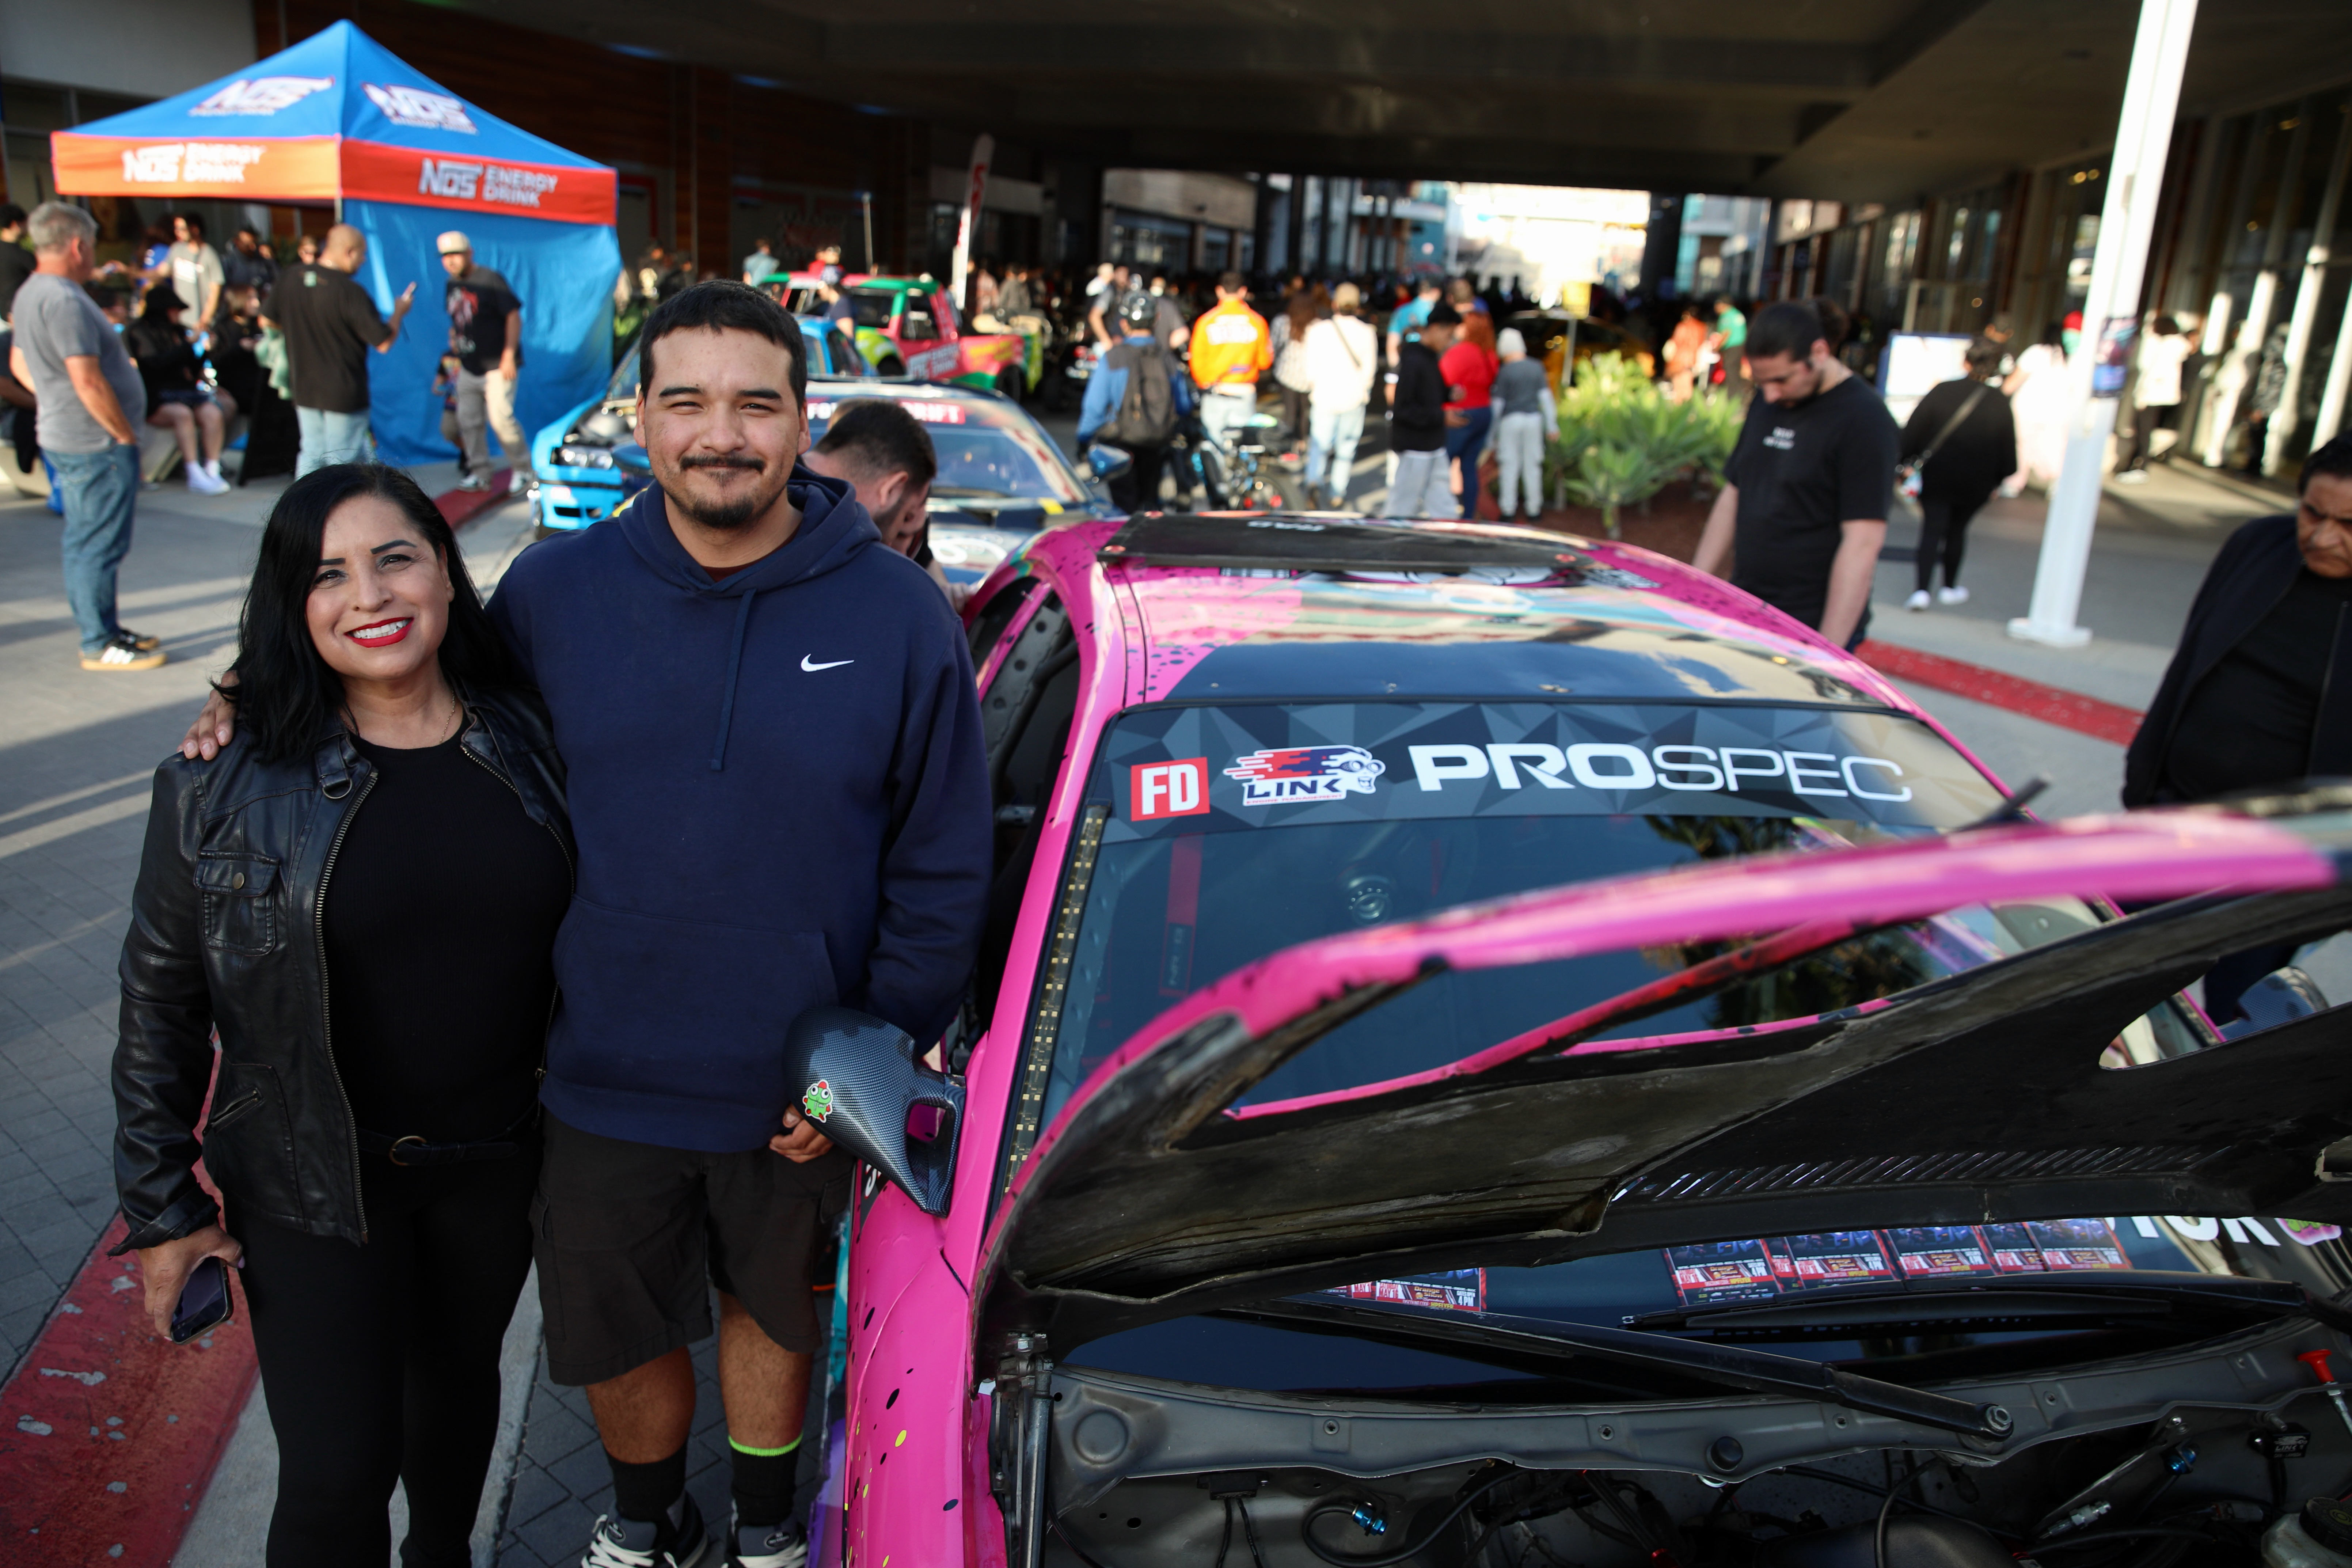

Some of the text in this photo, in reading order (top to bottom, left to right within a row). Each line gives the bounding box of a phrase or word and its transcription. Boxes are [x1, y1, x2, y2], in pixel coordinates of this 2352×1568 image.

[122, 143, 185, 182] NOS
[419, 158, 558, 199] NOS ENERGY
[483, 181, 540, 207] DRINK
[1408, 743, 1912, 802] PROSPEC
[1141, 763, 1200, 815] FD
[1247, 778, 1344, 799] LINK
[1282, 794, 1343, 803] MANAGEMENT
[1379, 1288, 1391, 1297] MAY
[1458, 1296, 1474, 1306] 4 PM
